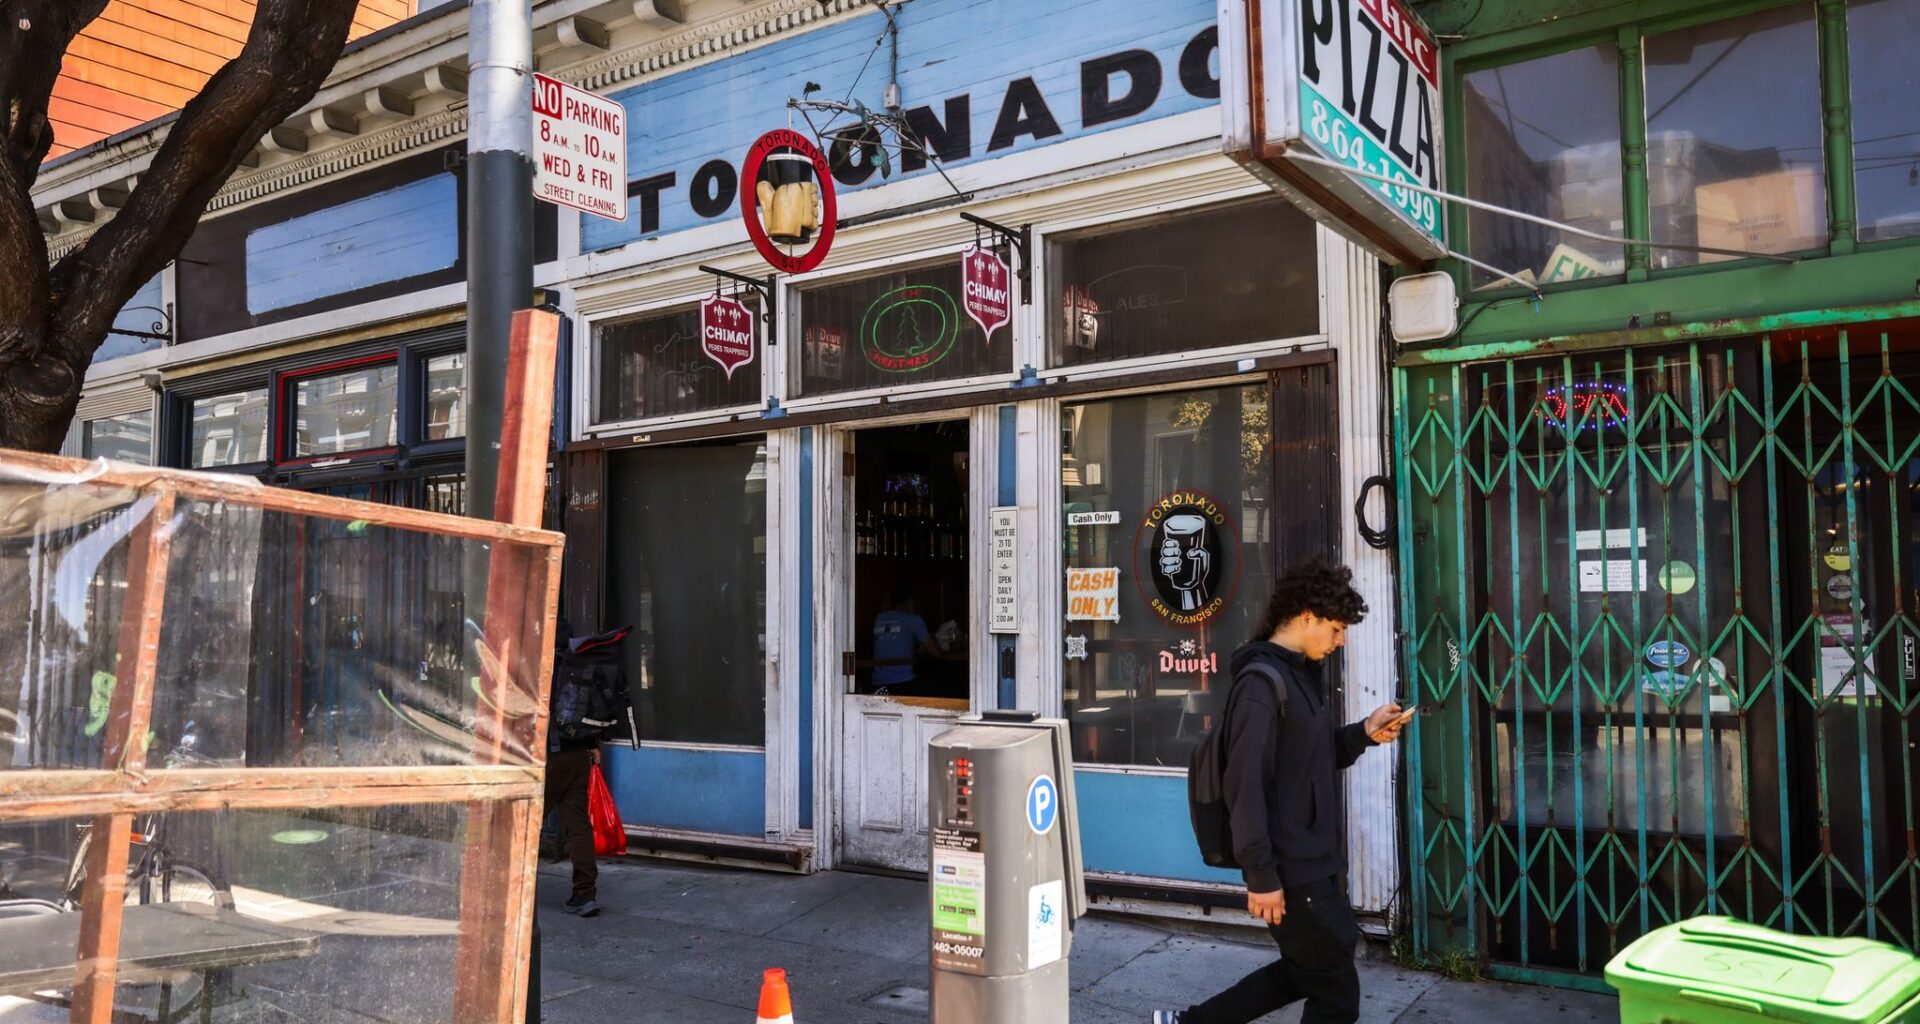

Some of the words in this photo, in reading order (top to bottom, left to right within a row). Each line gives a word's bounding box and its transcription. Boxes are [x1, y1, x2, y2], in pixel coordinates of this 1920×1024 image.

[534, 78, 559, 114] NO
[566, 97, 620, 136] PARKING
[1301, 0, 1438, 193] PIZZA
[627, 25, 1222, 235] TOONADO
[540, 120, 550, 142] 8
[553, 134, 570, 149] A.M.
[584, 134, 599, 158] 10
[602, 150, 618, 165] A.M.
[756, 131, 826, 172] TORONADO
[543, 152, 571, 177] WED
[577, 164, 586, 183] &
[592, 168, 612, 191] FRI
[1311, 99, 1436, 231] 864-1999
[544, 183, 574, 202] STREET
[578, 193, 617, 214] CLEANING
[781, 257, 803, 271] 547
[967, 280, 1007, 304] CHIMAY
[705, 325, 750, 345] CHIMAY
[1000, 518, 1010, 526] YOU
[1073, 514, 1092, 523] Cash
[1094, 513, 1112, 523] Only
[1144, 492, 1225, 530] TORONADO
[994, 529, 1008, 537] MUST
[1009, 528, 1016, 536] BE
[1005, 539, 1011, 547] TO
[997, 550, 1013, 558] ENTER
[998, 576, 1012, 584] OPEN
[998, 587, 1012, 595] DAILY
[1069, 571, 1116, 592] CASH
[1070, 597, 1115, 618] ONLY
[1151, 598, 1170, 617] SAN
[1170, 597, 1223, 625] FRANCISCO
[1159, 650, 1218, 674] Duvel
[1904, 639, 1913, 669] PULL
[1034, 785, 1050, 826] P
[942, 931, 967, 941] Location
[934, 942, 983, 958] 462-05007
